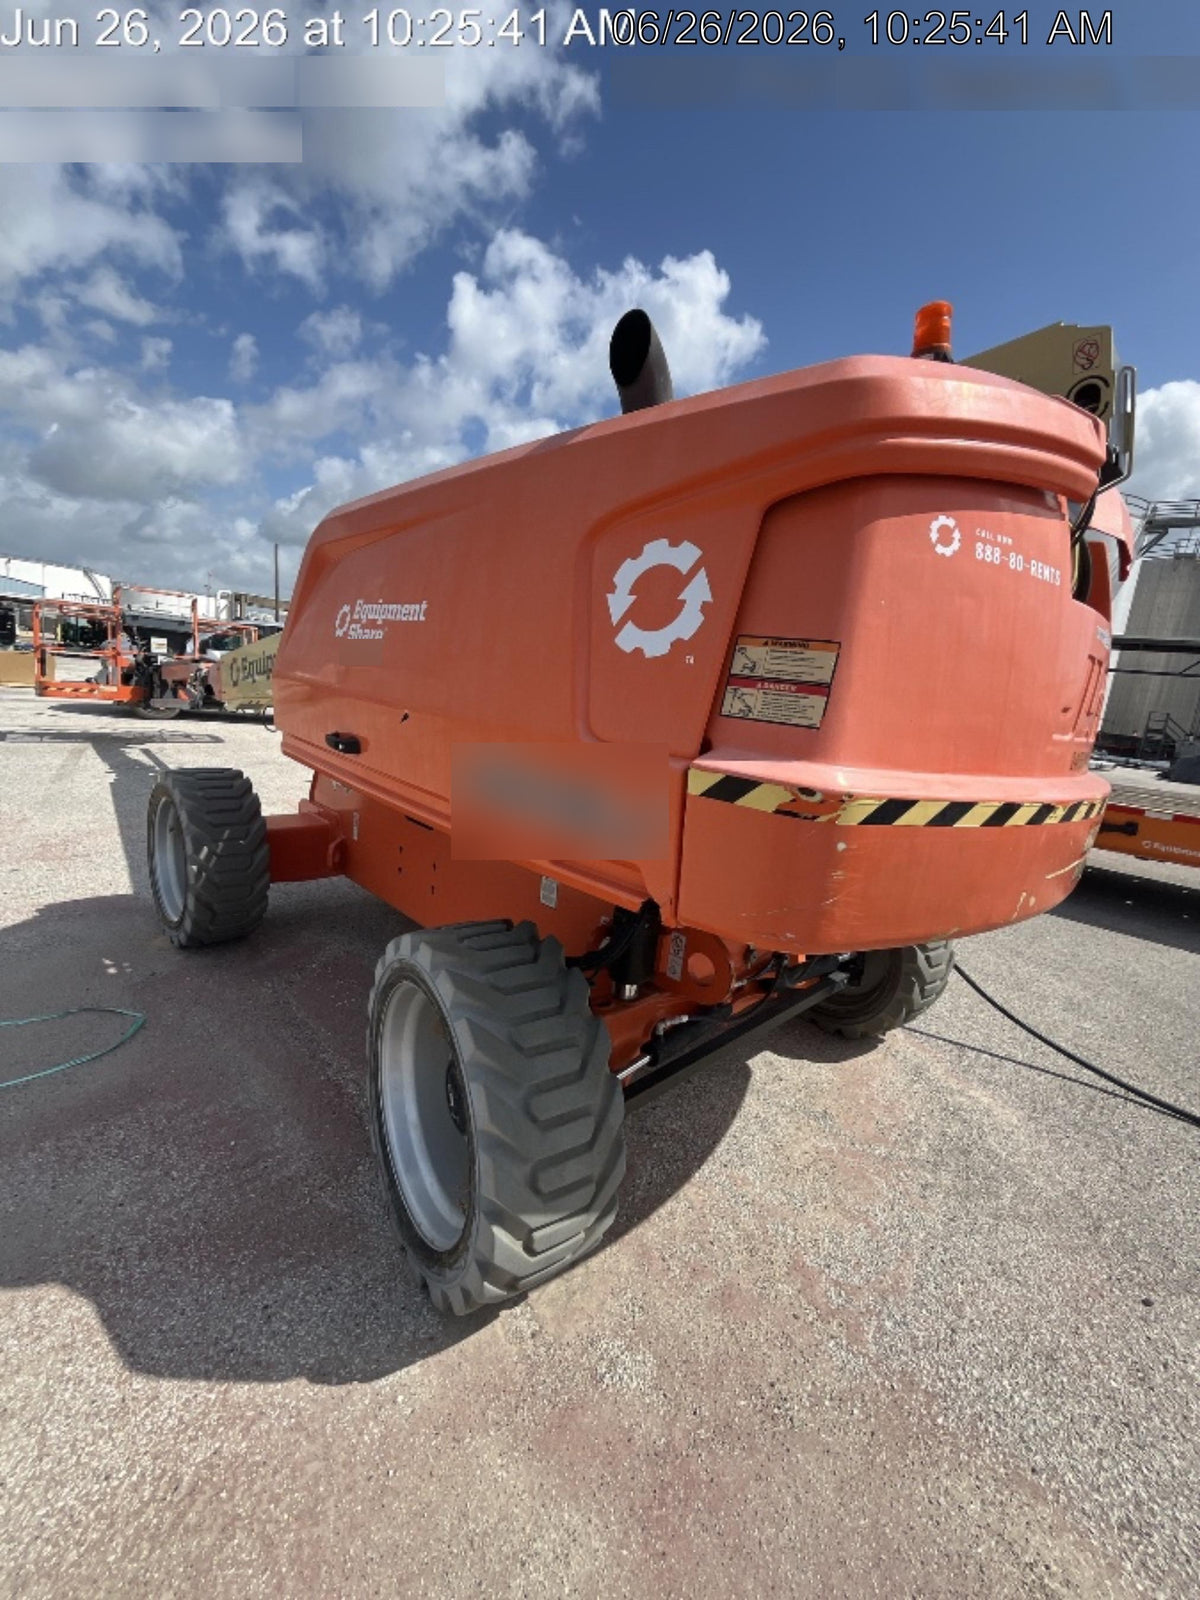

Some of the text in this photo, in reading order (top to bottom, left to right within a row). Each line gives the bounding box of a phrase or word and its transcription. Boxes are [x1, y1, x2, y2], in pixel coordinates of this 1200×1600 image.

[975, 541, 1061, 587] 888-80-RENTS
[353, 599, 427, 625] Equipment
[241, 650, 277, 684] Equip
